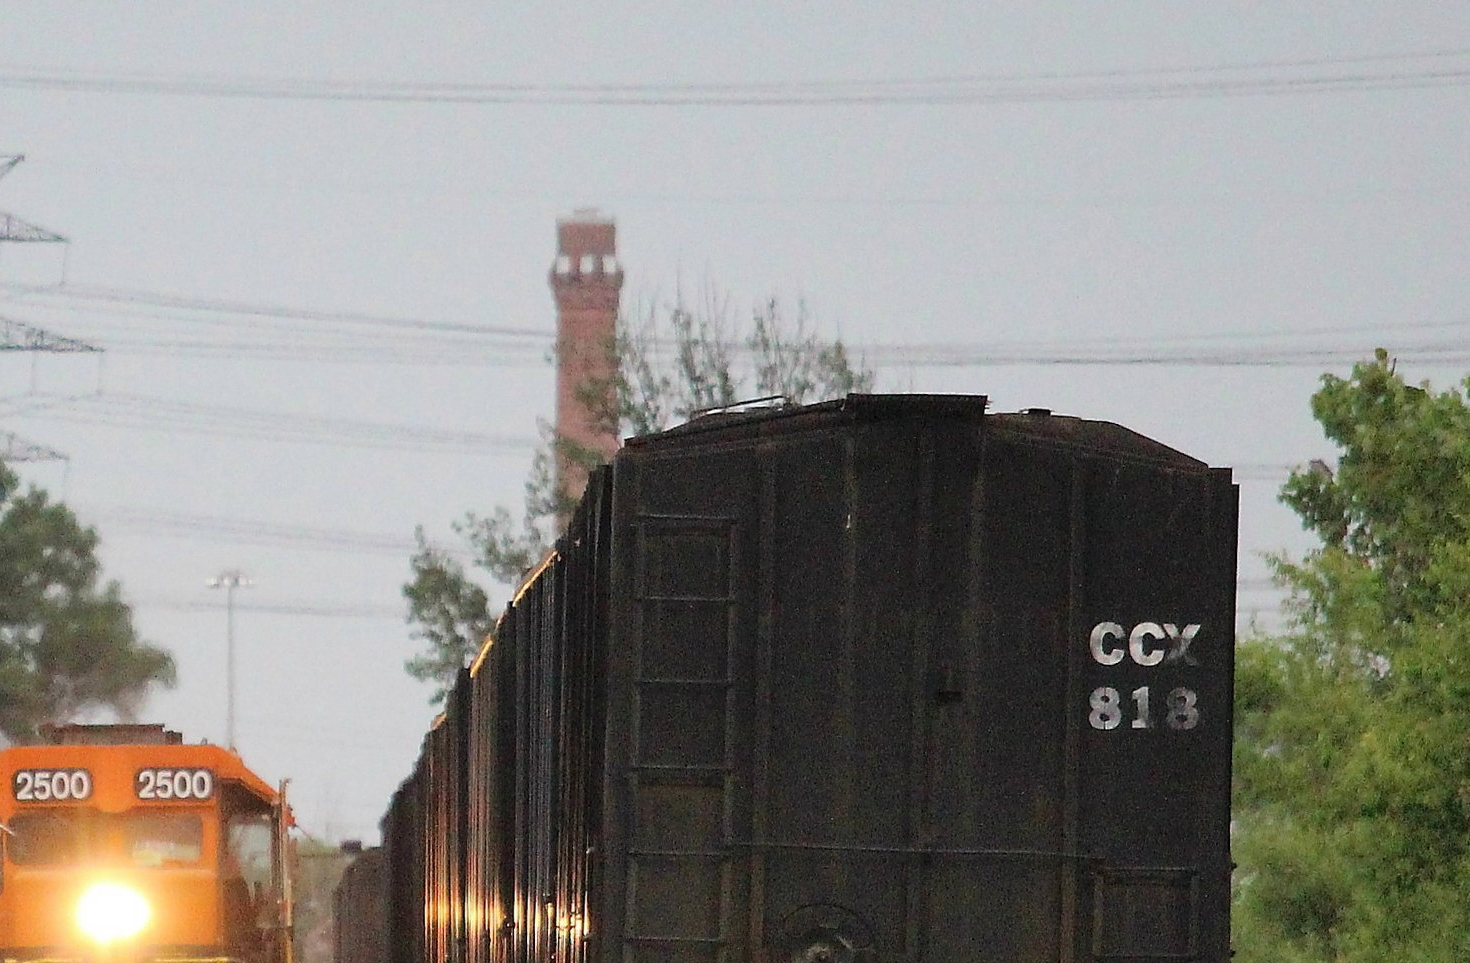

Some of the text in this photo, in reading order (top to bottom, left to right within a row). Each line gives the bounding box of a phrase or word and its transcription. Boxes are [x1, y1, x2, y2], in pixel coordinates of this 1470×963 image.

[1089, 621, 1201, 666] CCX
[1088, 686, 1200, 730] 818
[16, 771, 91, 800] 2500
[138, 770, 212, 799] 2500
